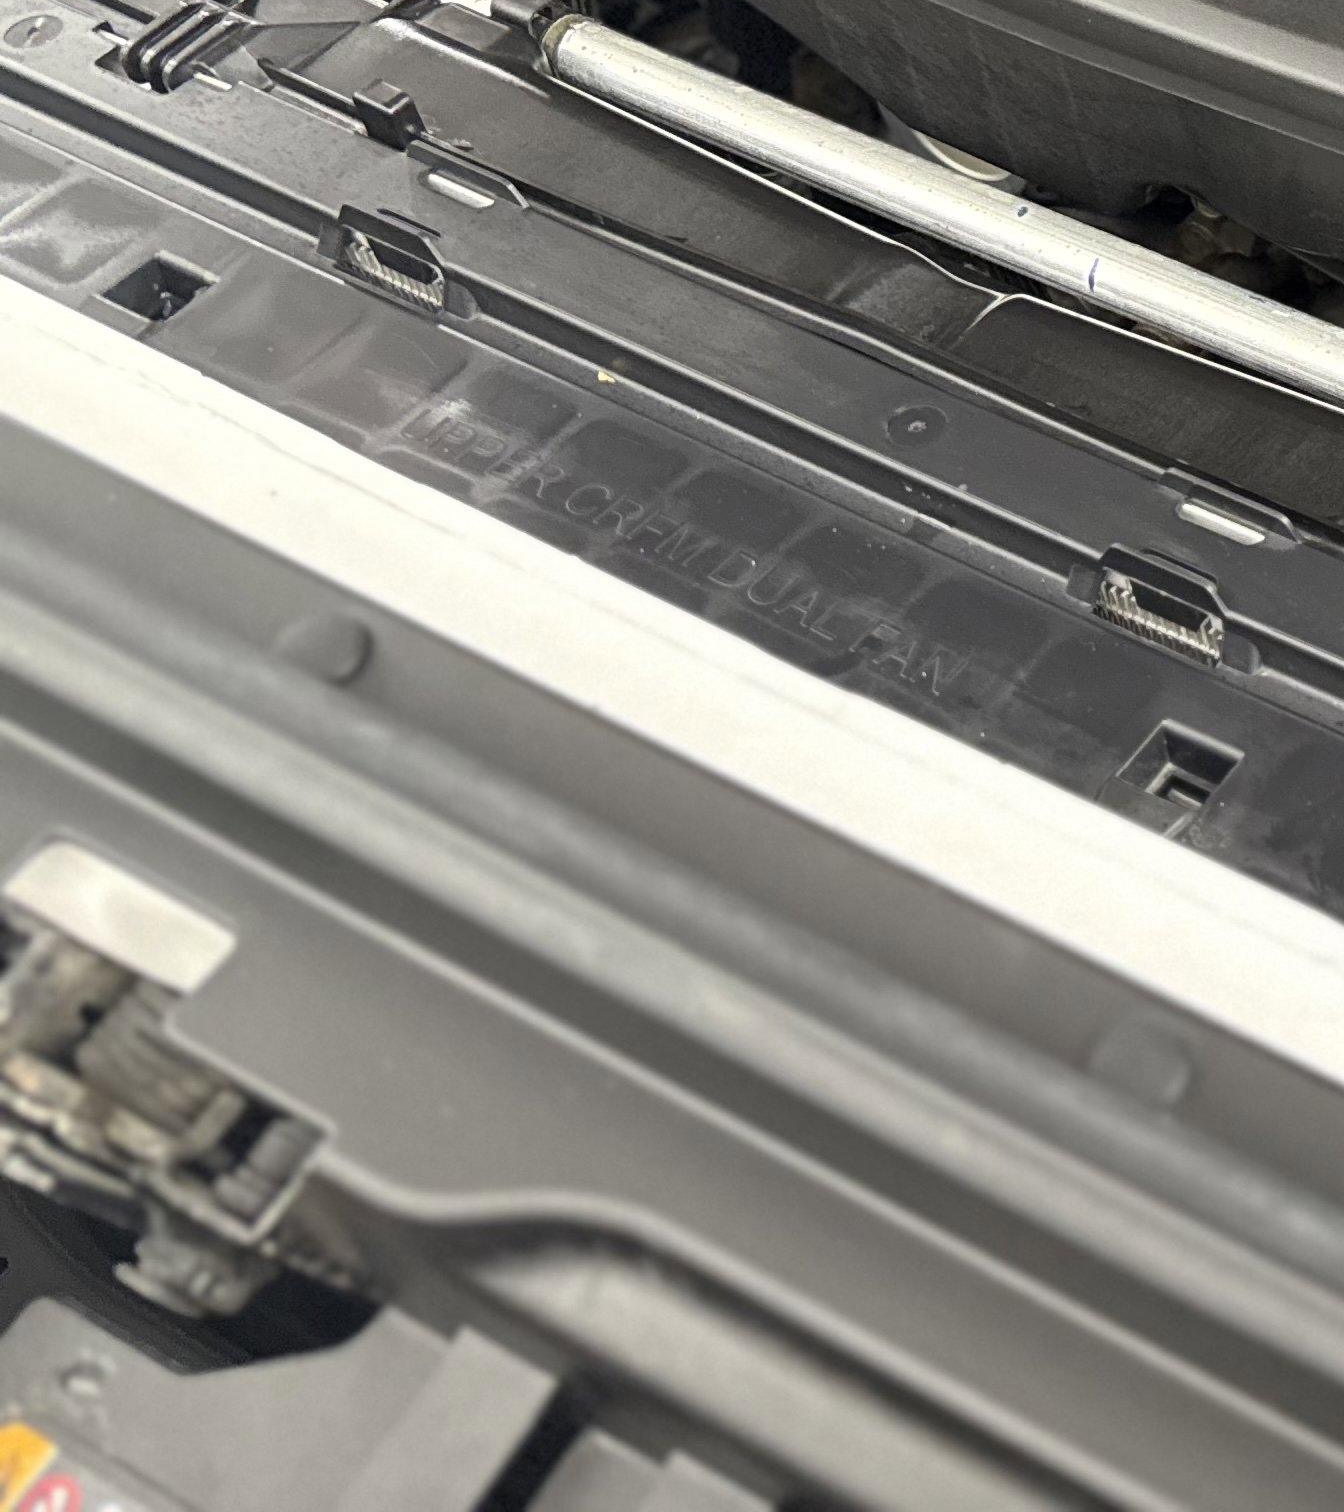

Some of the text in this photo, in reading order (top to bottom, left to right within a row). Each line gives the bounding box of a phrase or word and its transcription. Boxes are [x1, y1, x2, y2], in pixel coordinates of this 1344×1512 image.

[401, 408, 974, 697] UPPER CRFM DUAL FAN
